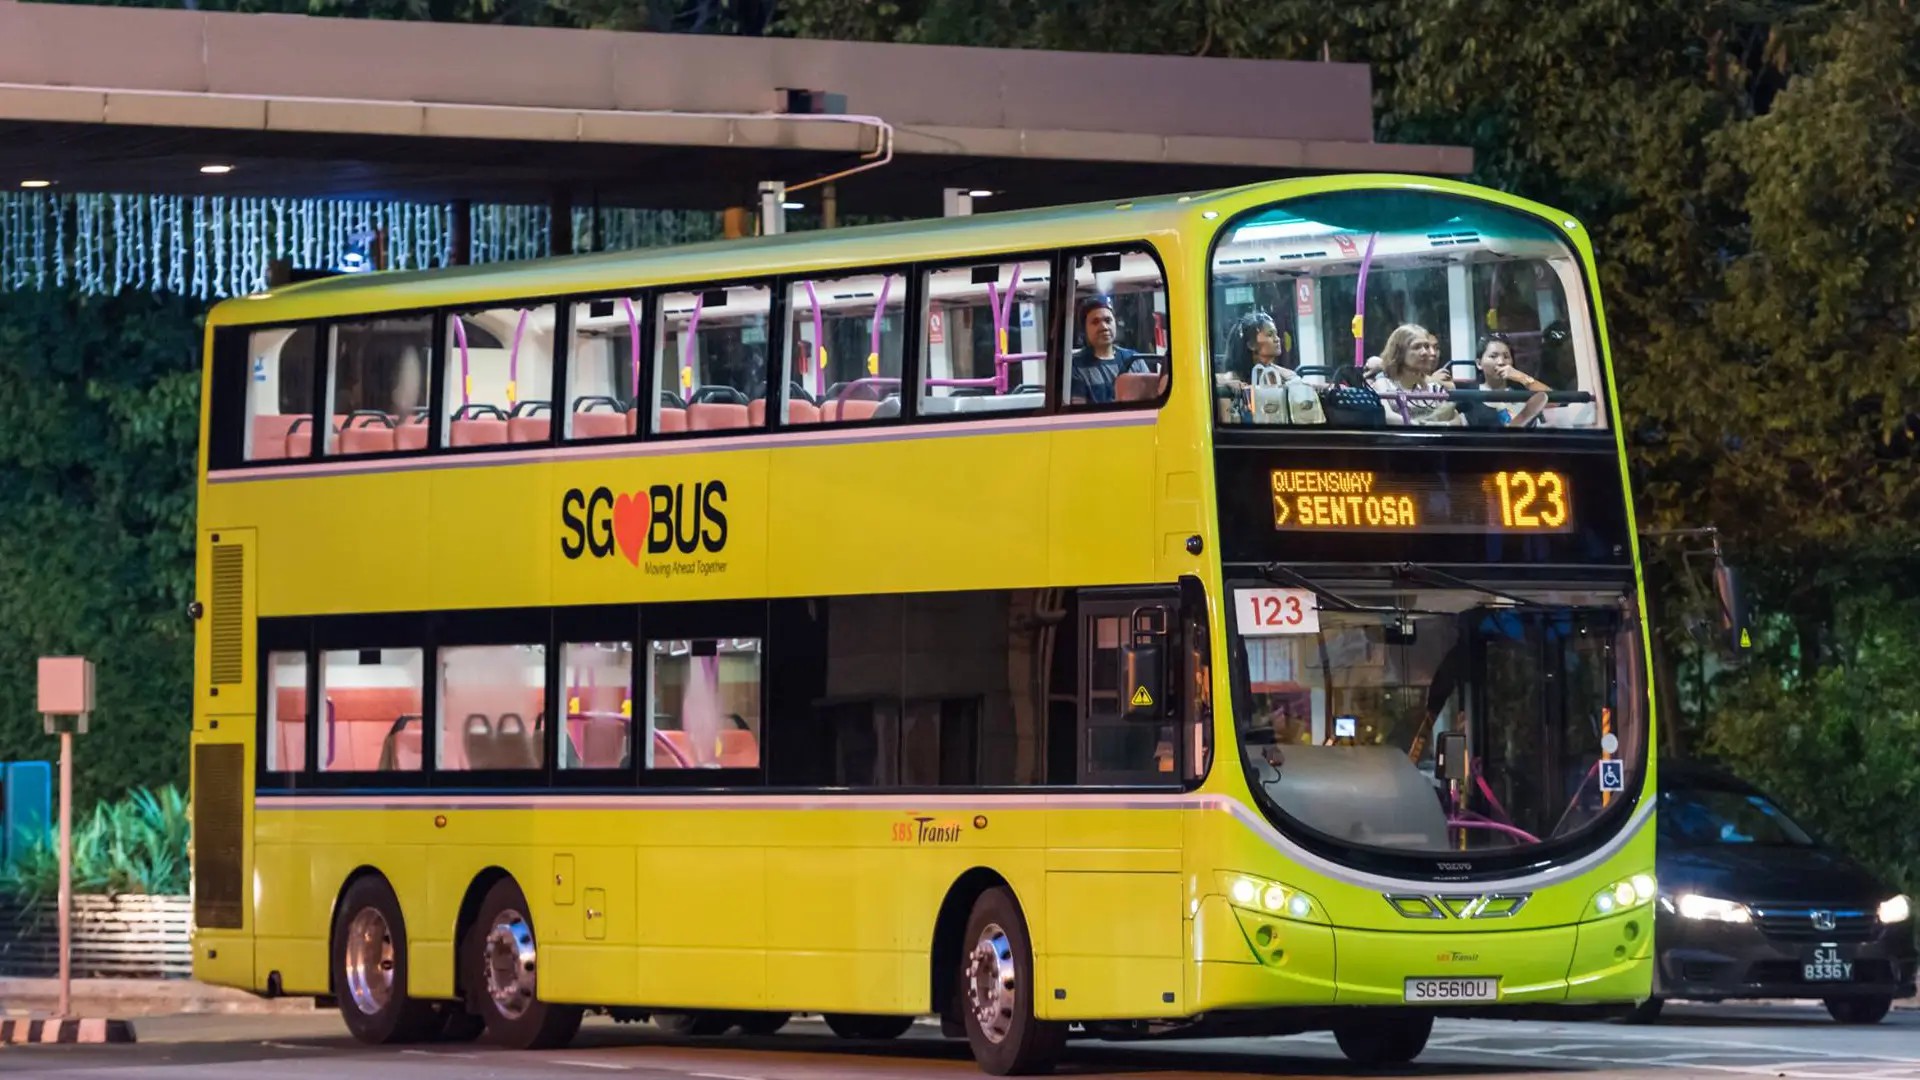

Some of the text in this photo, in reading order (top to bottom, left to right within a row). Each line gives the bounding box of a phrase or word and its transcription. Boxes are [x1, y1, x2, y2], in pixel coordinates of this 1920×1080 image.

[1272, 471, 1373, 494] QUEENSWAY
[1298, 495, 1416, 526] SENTOSA
[1495, 471, 1567, 528] 123
[644, 560, 728, 578] Moving Ahead Together
[1250, 597, 1304, 627] 123
[892, 817, 963, 846] SBS Transit
[1814, 949, 1841, 963] SJL
[1416, 981, 1488, 998] SG5610U
